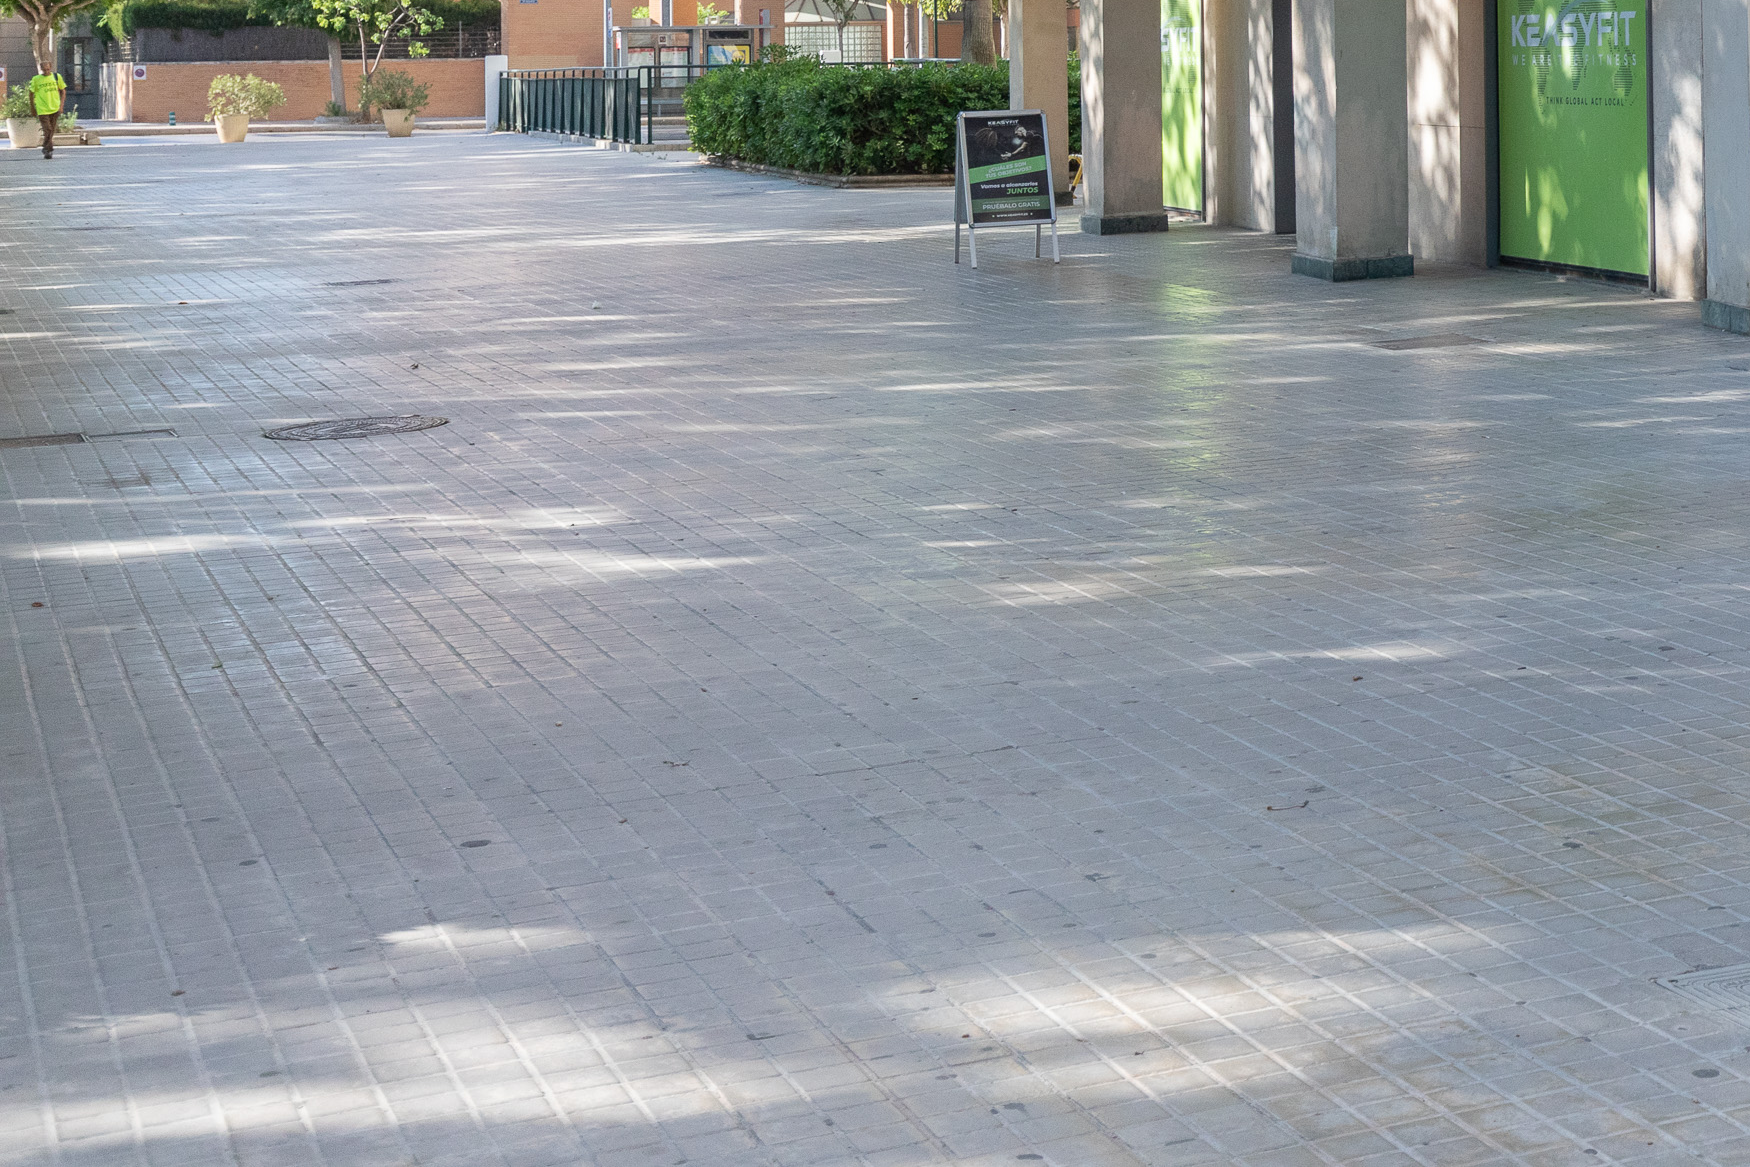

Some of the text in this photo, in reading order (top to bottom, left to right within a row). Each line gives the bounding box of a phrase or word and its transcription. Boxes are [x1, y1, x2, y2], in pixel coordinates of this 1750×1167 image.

[1511, 11, 1637, 47] KEASYFIT
[1512, 54, 1525, 65] WE
[1532, 54, 1551, 66] ARE
[1585, 54, 1637, 66] FITNESS
[1546, 96, 1624, 107] THINK GLOBAL ACT LOCAL
[1007, 186, 1039, 194] JUNTOS
